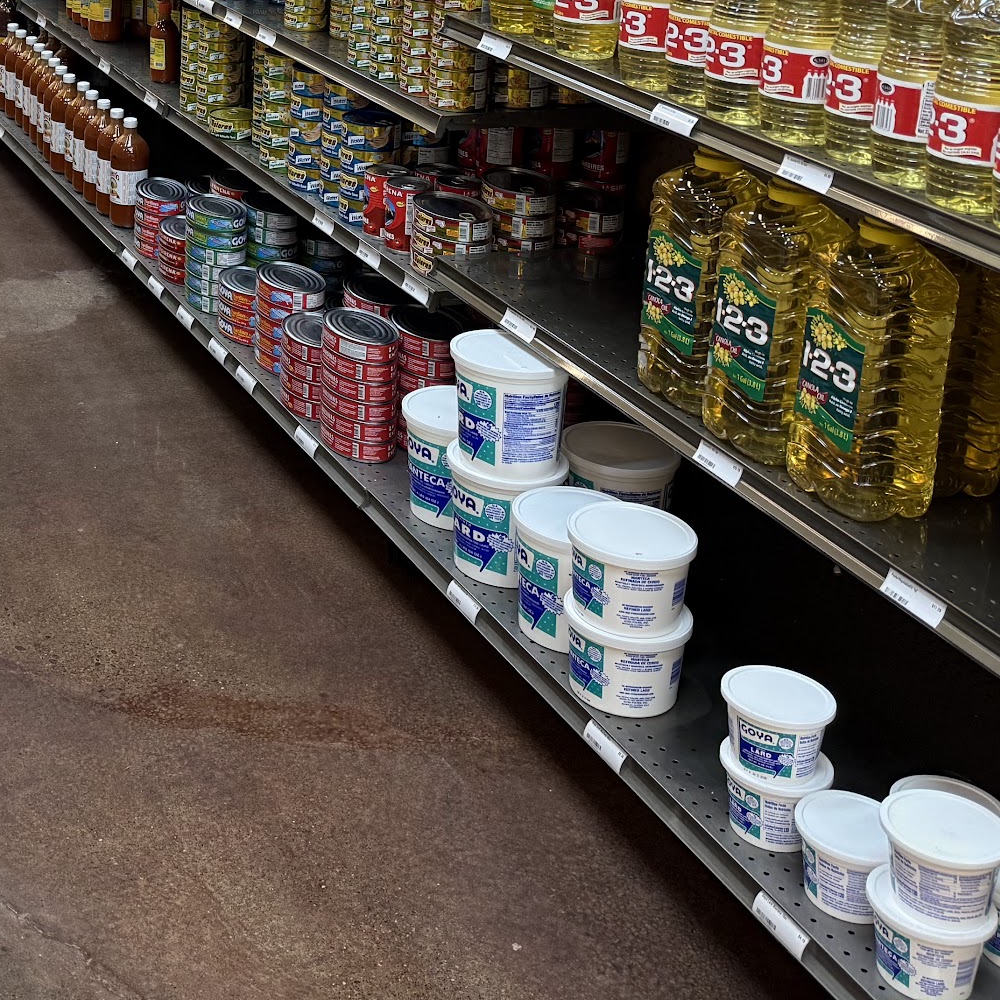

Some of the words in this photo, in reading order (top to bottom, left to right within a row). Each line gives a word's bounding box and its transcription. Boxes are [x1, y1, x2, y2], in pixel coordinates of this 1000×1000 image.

[647, 294, 663, 305] CANOLA
[661, 304, 669, 312] OIL
[715, 334, 732, 347] CANOLA
[730, 346, 738, 355] OIL
[802, 379, 820, 393] CANOLA
[817, 392, 826, 401] OIL
[741, 723, 773, 743] GOYA
[750, 747, 772, 759] LARD
